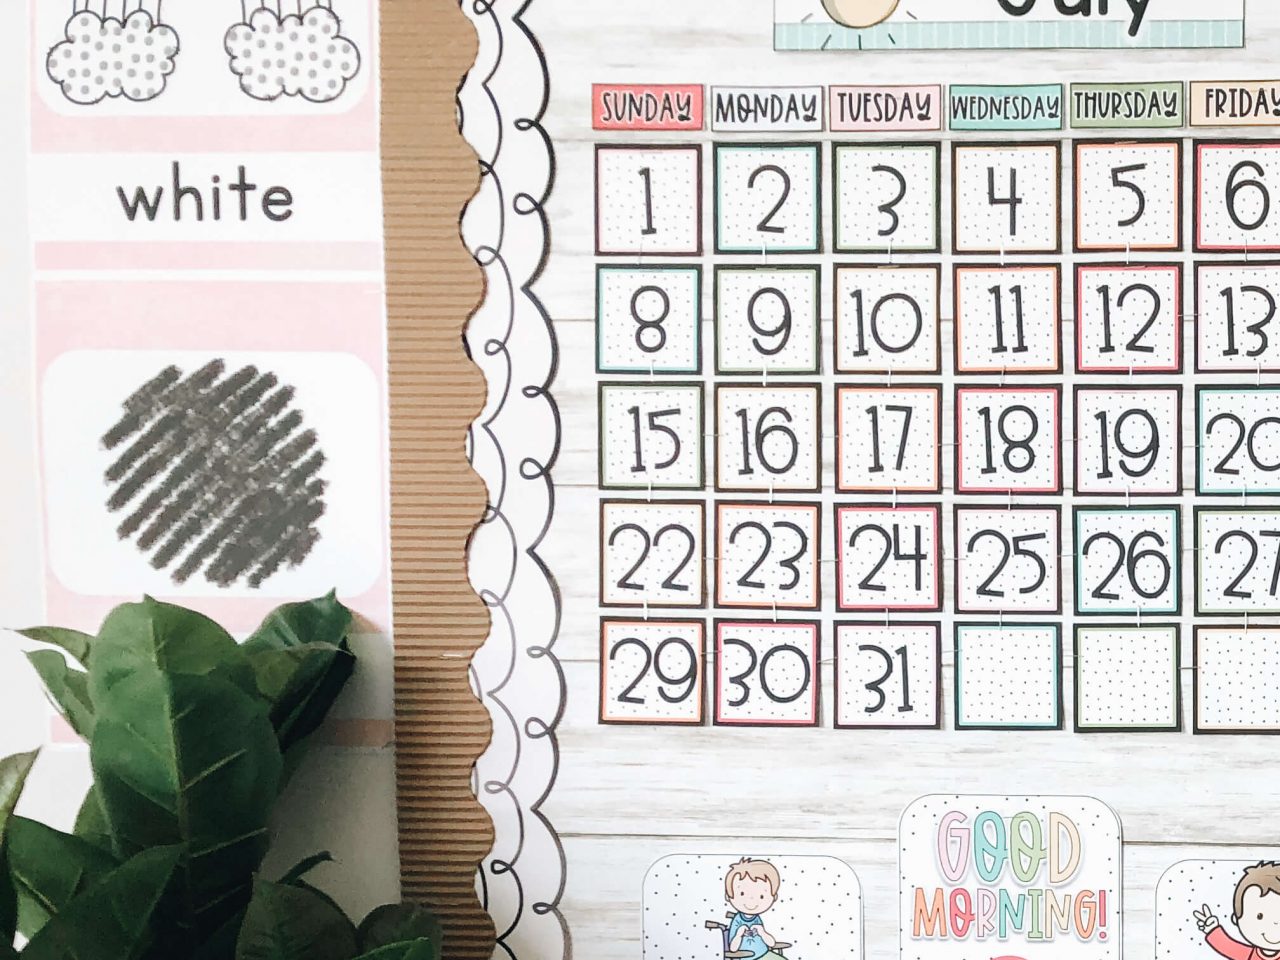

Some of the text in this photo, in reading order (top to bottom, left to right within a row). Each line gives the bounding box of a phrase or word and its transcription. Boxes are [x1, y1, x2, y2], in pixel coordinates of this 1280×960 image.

[601, 91, 692, 123] SUNDAY
[715, 93, 818, 123] MONDAY
[836, 92, 932, 123] TUESDAY
[951, 94, 1060, 121] WEDNESDAY
[1073, 90, 1178, 119] THURSDAY
[116, 161, 294, 223] white
[640, 169, 656, 234] 1
[747, 165, 790, 232] 2
[873, 166, 906, 235] 3
[988, 168, 1021, 235] 4
[1112, 164, 1145, 226] 5
[1226, 161, 1269, 230] 6
[631, 286, 669, 352] 8
[748, 288, 791, 355] 9
[851, 290, 922, 356] 10
[989, 286, 1028, 352] 11
[1097, 284, 1160, 352] 12
[1220, 286, 1276, 356] 13
[629, 407, 680, 472] 15
[736, 407, 797, 474] 16
[867, 406, 912, 472] 17
[978, 406, 1038, 473] 18
[1095, 409, 1159, 478] 19
[609, 524, 694, 590] 22
[730, 522, 807, 589] 23
[850, 524, 926, 591] 24
[968, 530, 1045, 596] 25
[1083, 530, 1170, 599] 26
[610, 638, 696, 703] 29
[724, 639, 810, 706] 30
[859, 645, 913, 712] 31
[936, 810, 1084, 885] GOOD
[912, 888, 1107, 941] MORNING!
